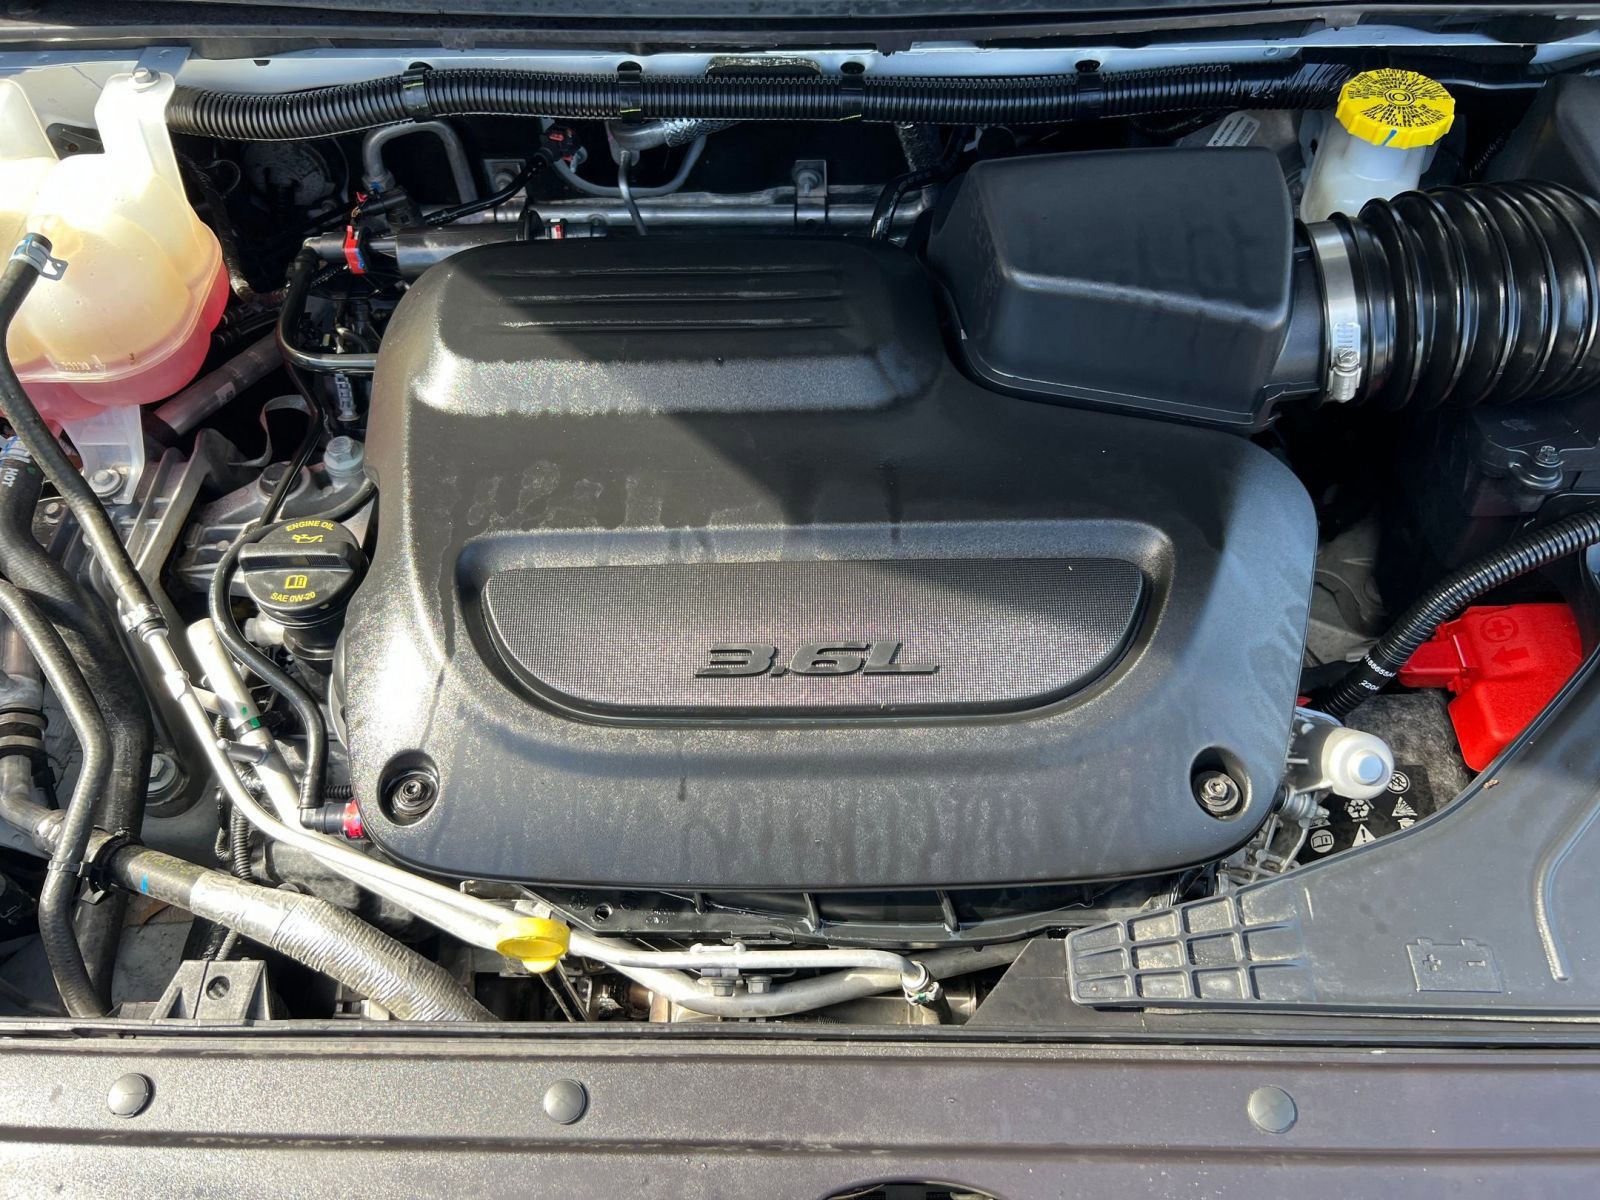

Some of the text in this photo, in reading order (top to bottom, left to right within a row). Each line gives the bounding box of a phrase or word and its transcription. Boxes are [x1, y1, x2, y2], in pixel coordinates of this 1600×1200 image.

[2, 468, 19, 488] HOT
[285, 520, 336, 532] ENGINE OIL
[271, 591, 316, 603] SAE 0W-20
[694, 640, 938, 677] 3.6L
